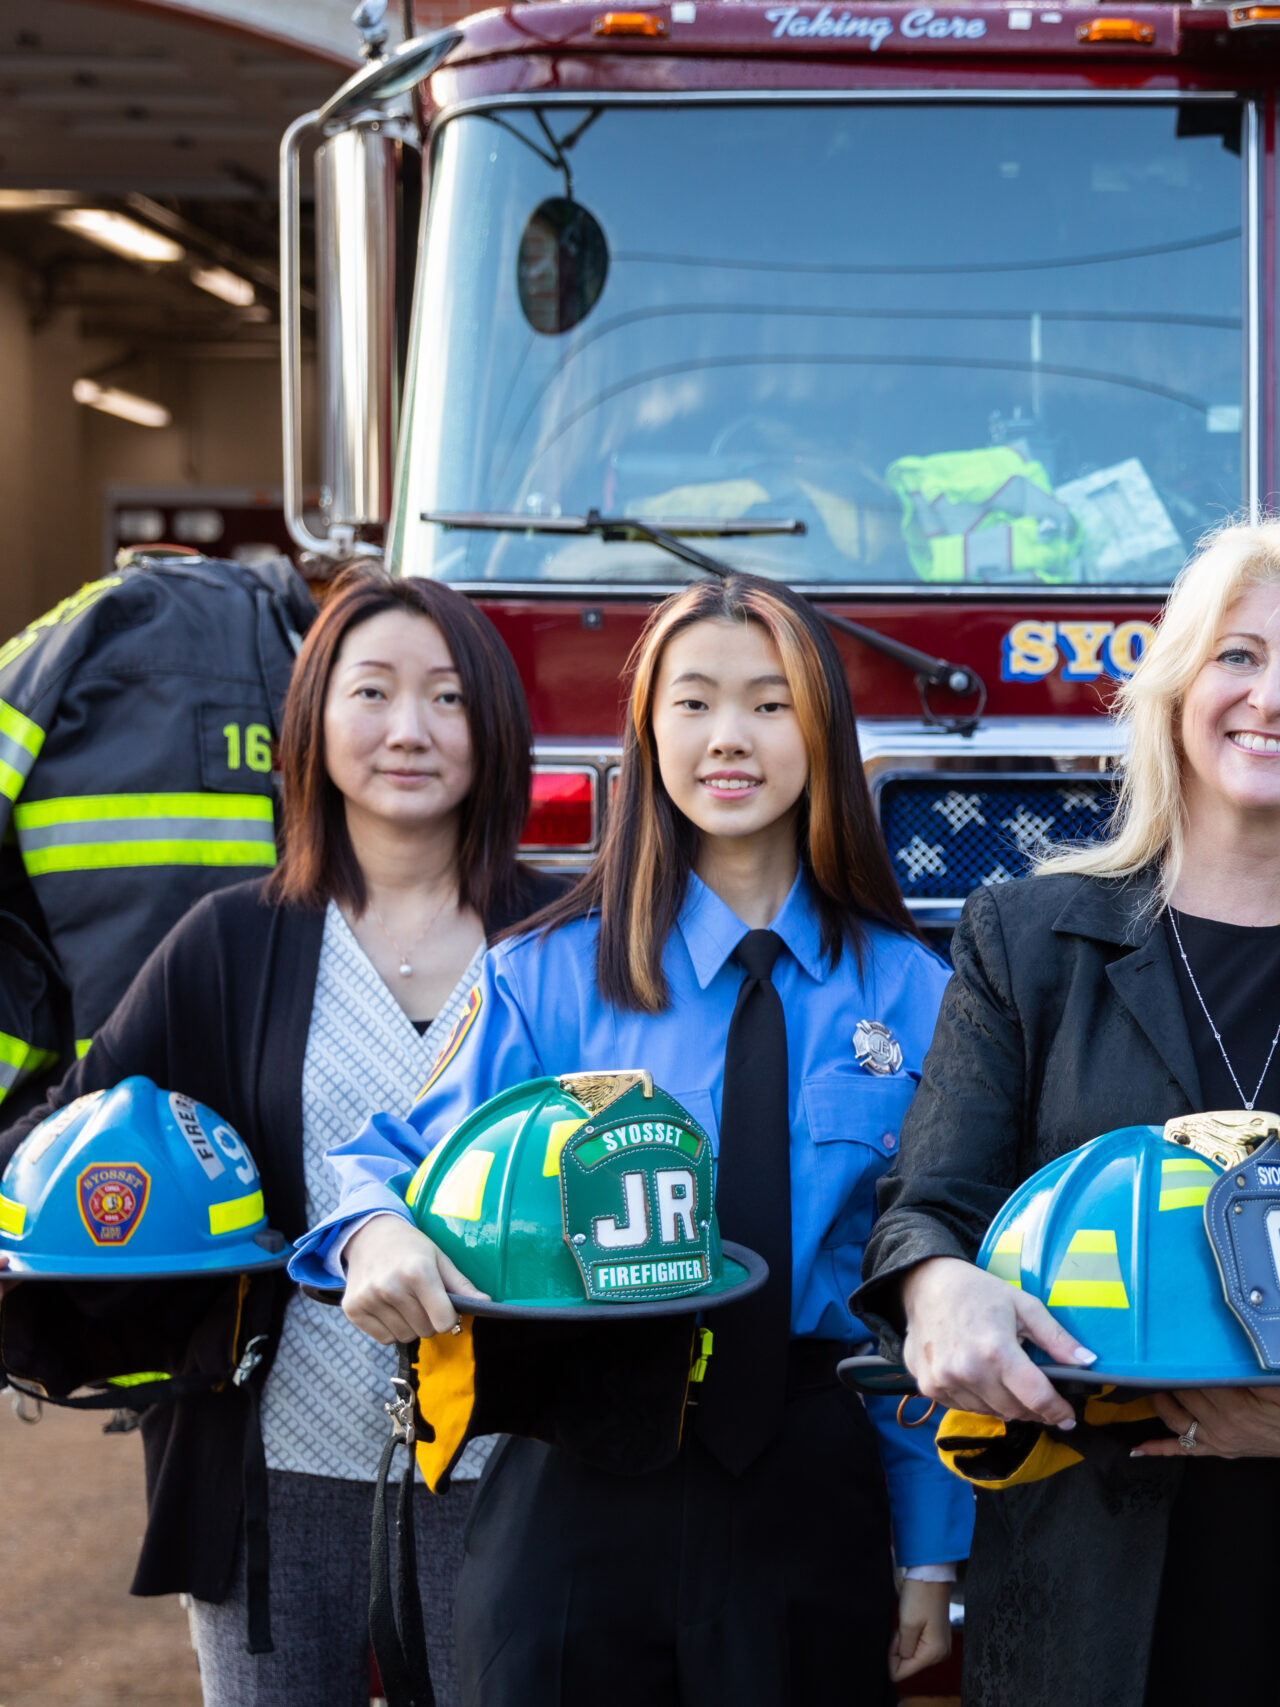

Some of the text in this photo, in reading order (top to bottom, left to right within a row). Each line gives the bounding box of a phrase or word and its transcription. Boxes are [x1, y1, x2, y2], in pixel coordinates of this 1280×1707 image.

[765, 6, 987, 51] Taking Care
[223, 722, 272, 773] 16
[602, 1122, 684, 1152] SYOSSET
[83, 1169, 143, 1190] SYOSSET
[595, 1169, 699, 1248] JR
[598, 1259, 703, 1288] FIREFIGHTER
